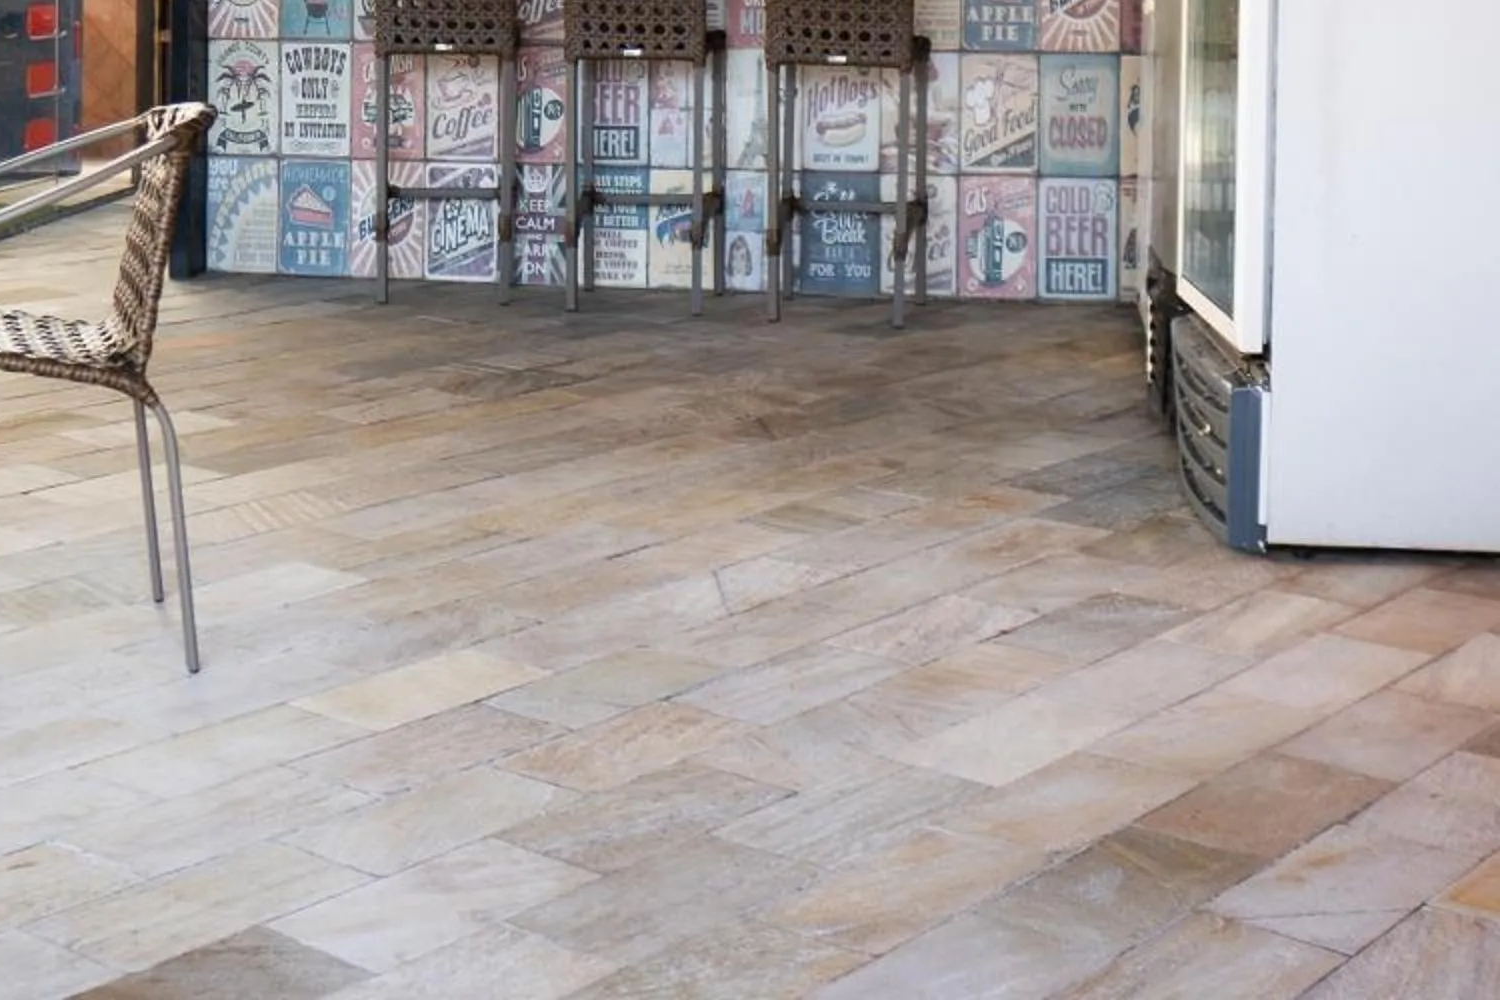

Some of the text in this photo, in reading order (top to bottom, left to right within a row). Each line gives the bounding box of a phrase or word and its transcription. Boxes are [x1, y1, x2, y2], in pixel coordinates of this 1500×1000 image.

[968, 5, 1034, 21] APPLE
[981, 25, 1019, 41] PIE
[285, 46, 347, 76] COWBOYS
[301, 77, 329, 99] ONLY
[594, 83, 640, 125] EER
[432, 105, 493, 141] Coffee
[964, 122, 998, 158] Good
[1003, 99, 1036, 138] Food
[1049, 115, 1108, 150] CLOSED
[1046, 186, 1090, 214] COLD
[431, 203, 491, 257] CINEMA
[516, 217, 555, 231] CALM
[1045, 216, 1108, 256] BEER
[283, 232, 345, 248] APPLE
[297, 249, 331, 265] PIE
[525, 262, 546, 275] ON
[809, 263, 871, 278] FOR YOU
[1050, 263, 1103, 291] HERE!
